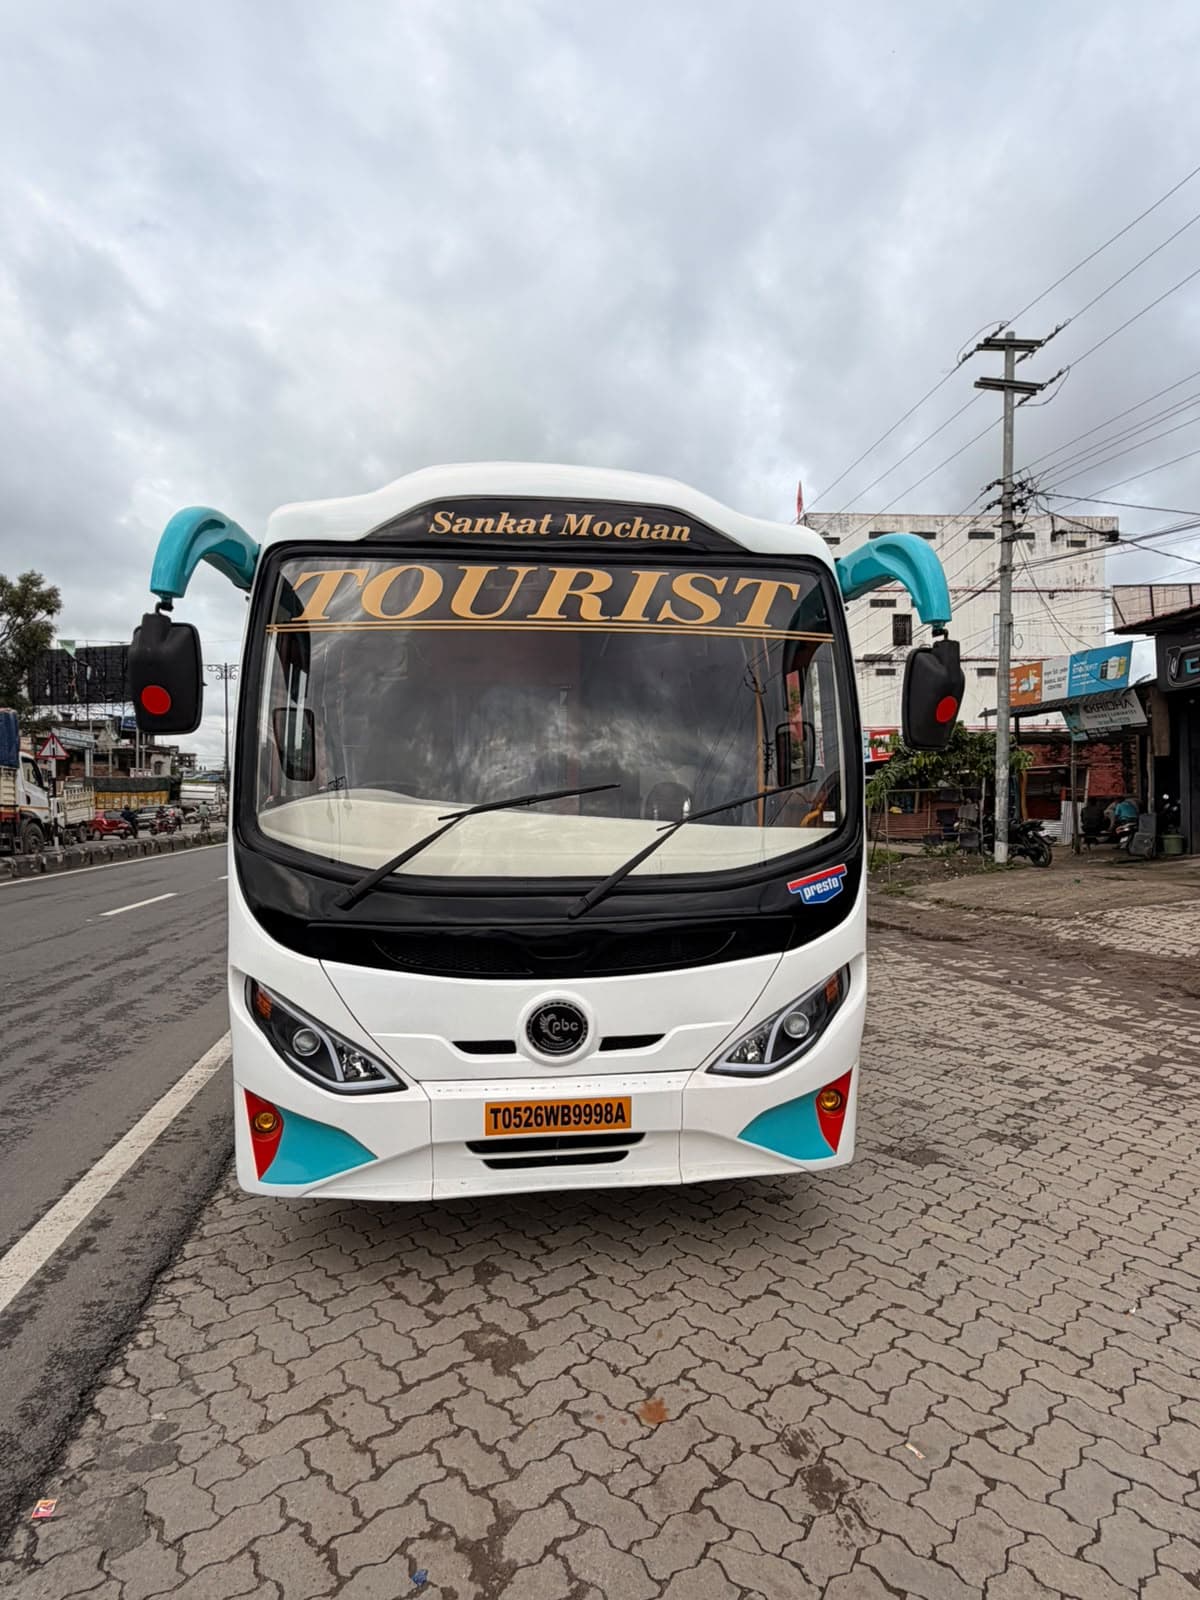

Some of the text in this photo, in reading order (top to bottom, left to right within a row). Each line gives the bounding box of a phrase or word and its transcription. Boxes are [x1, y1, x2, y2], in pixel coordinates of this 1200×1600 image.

[428, 510, 692, 543] Sankat Mochan
[293, 565, 800, 628] TOURIST
[803, 876, 840, 901] presto
[552, 1018, 579, 1034] pbc
[489, 1102, 626, 1129] T0526WB9998A
